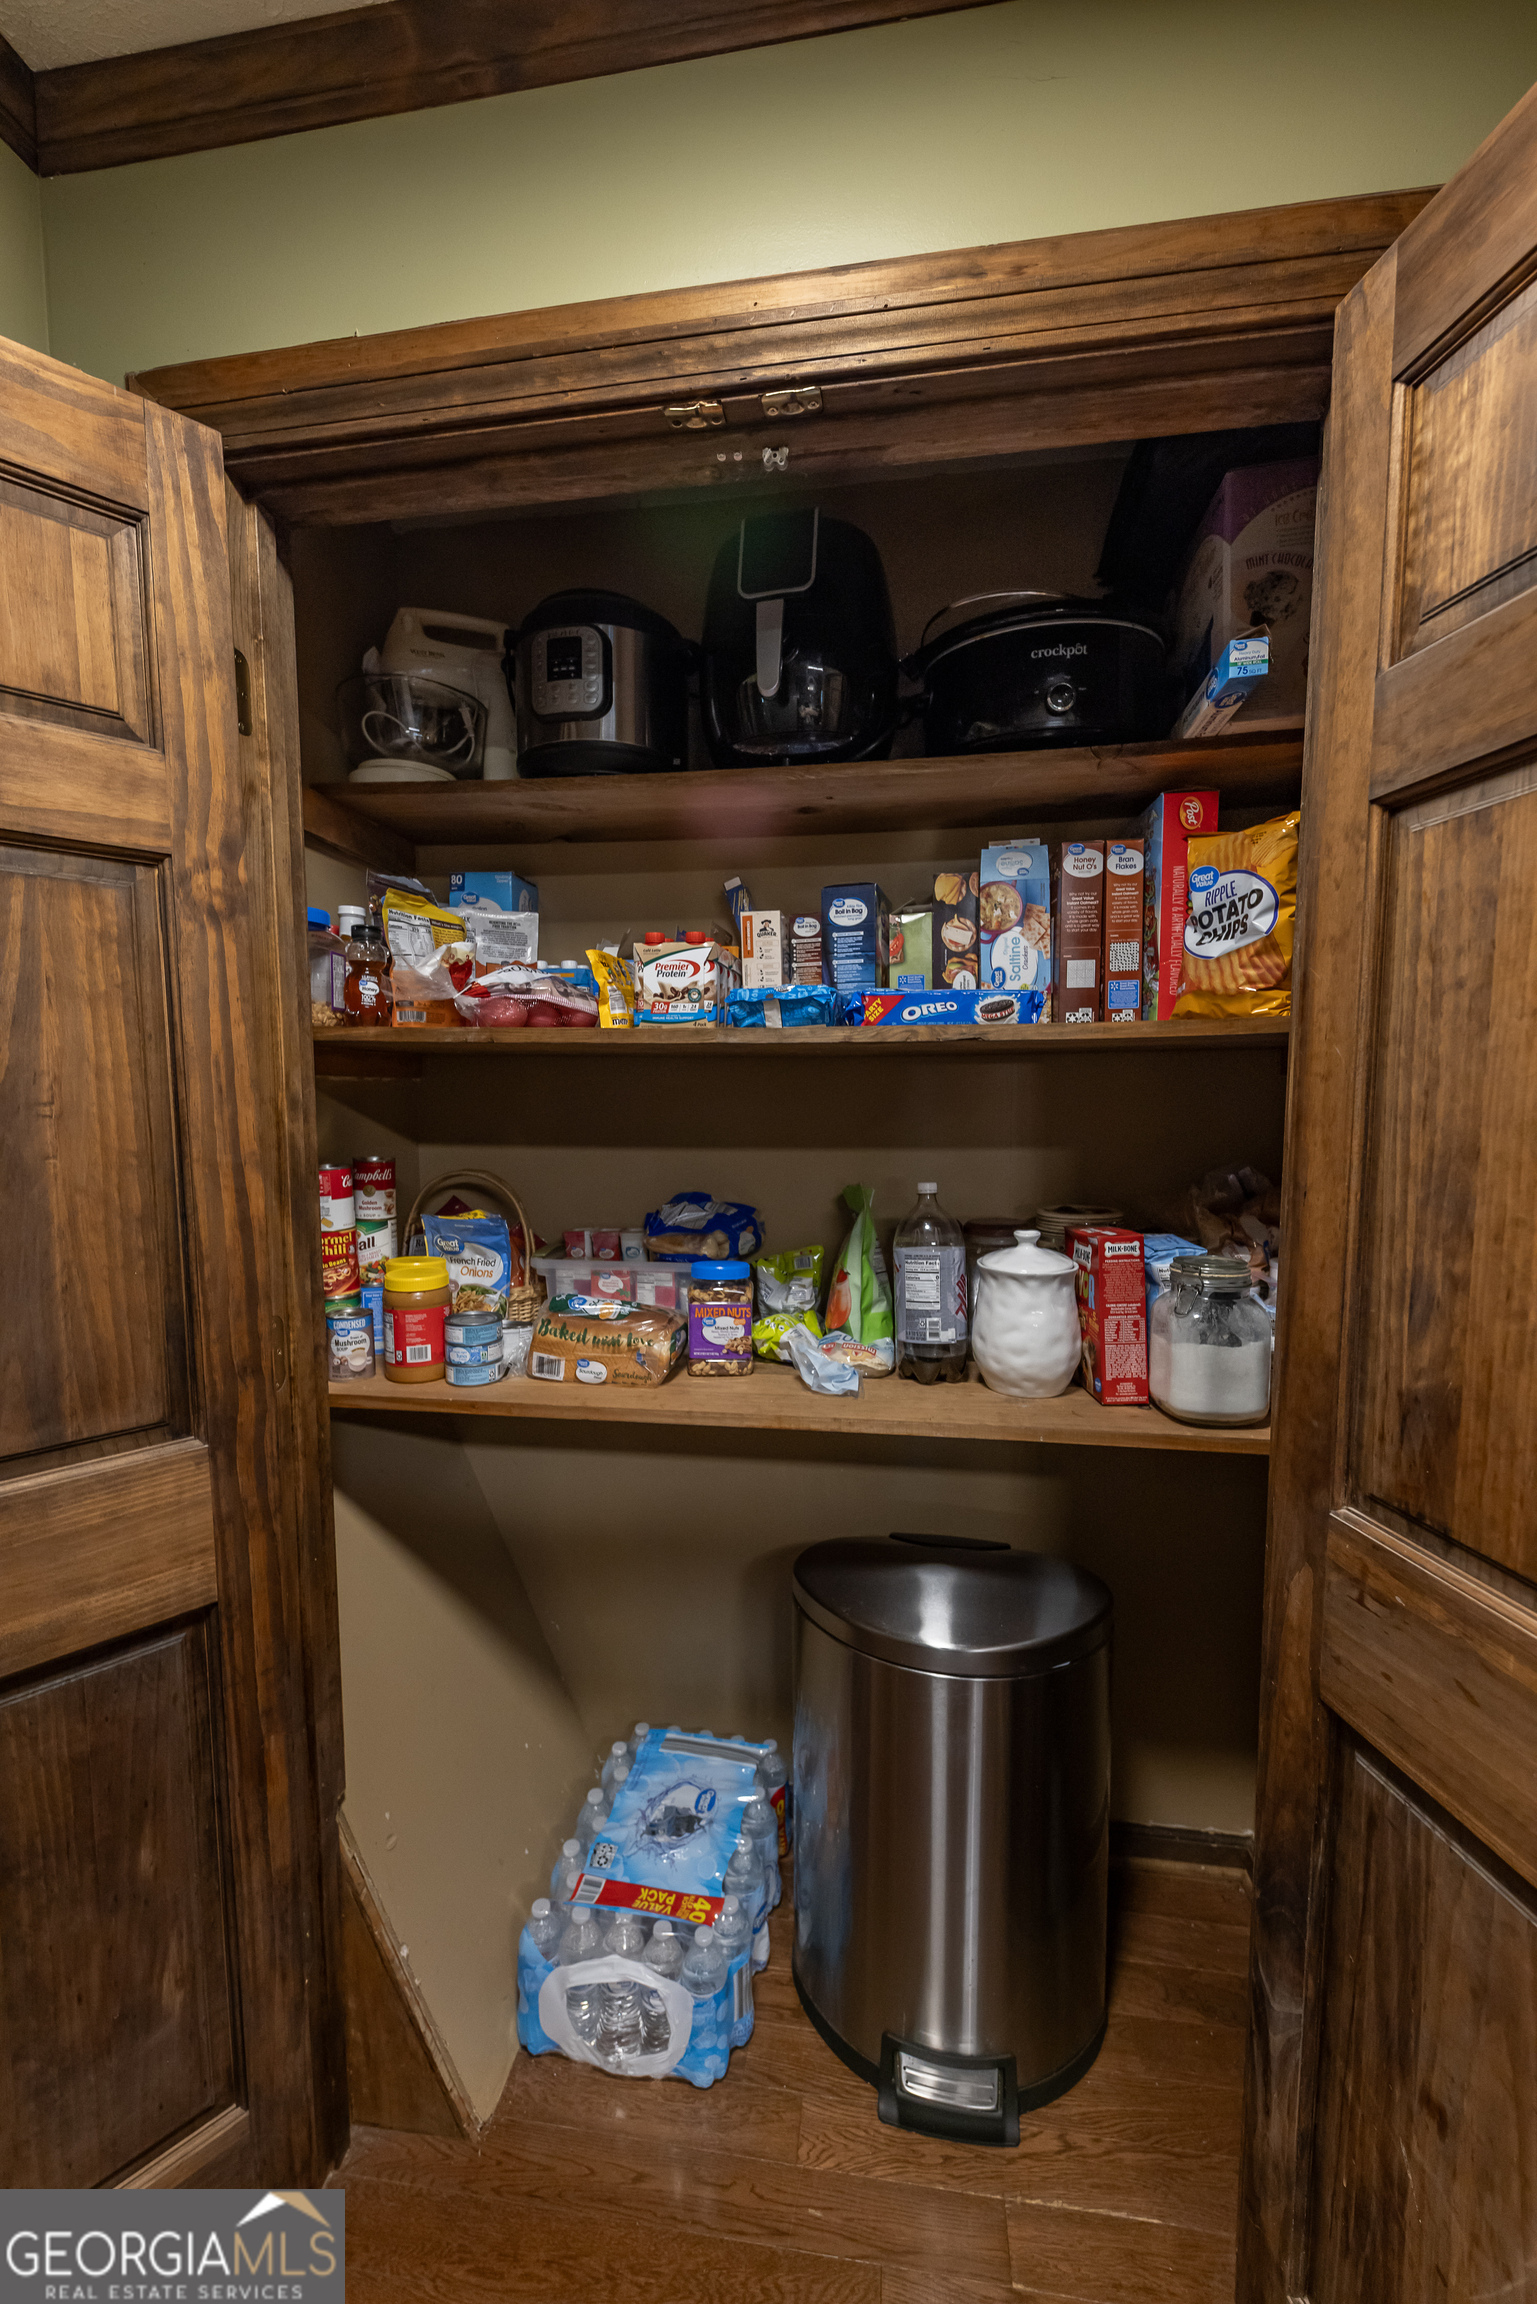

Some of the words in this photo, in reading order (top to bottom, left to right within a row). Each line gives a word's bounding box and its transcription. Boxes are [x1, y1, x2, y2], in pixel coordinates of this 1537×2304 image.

[1246, 553, 1269, 570] MINT
[1030, 642, 1088, 659] crockpot
[1237, 666, 1248, 675] 75
[1184, 801, 1199, 825] Post
[451, 875, 462, 884] 80
[1172, 865, 1184, 905] NATURALLY
[1191, 871, 1214, 884] Great
[1195, 880, 1213, 889] Value
[1204, 880, 1237, 907] RIPPLE
[388, 908, 412, 920] Nutrition
[1190, 888, 1263, 933] POTATO
[1171, 913, 1183, 958] ARTIFICIALLY
[1195, 913, 1249, 946] CHIPS
[655, 962, 689, 971] Premier
[1009, 936, 1020, 982] Saltine
[656, 970, 686, 978] Protein
[653, 1002, 667, 1010] 30g
[902, 1001, 958, 1021] OREO
[868, 1007, 884, 1022] SIZE
[354, 1168, 392, 1183] ampbell's
[321, 1232, 352, 1245] ormel
[437, 1238, 459, 1247] Great
[330, 1258, 347, 1266] Beans
[449, 1256, 476, 1266] French
[477, 1257, 496, 1267] Fried
[460, 1265, 493, 1278] Onions
[1078, 1268, 1095, 1310] VOR
[695, 1307, 725, 1318] MIXED
[727, 1307, 751, 1318] NUTS
[333, 1318, 366, 1330] CONDENSED
[538, 1318, 590, 1345] Baked
[626, 1332, 654, 1347] love
[334, 1337, 367, 1347] Mushroom
[612, 1368, 651, 1383] Sourdough
[638, 1887, 676, 1905] PACK
[631, 1899, 672, 1915] VALUE
[689, 1897, 712, 1924] 40
